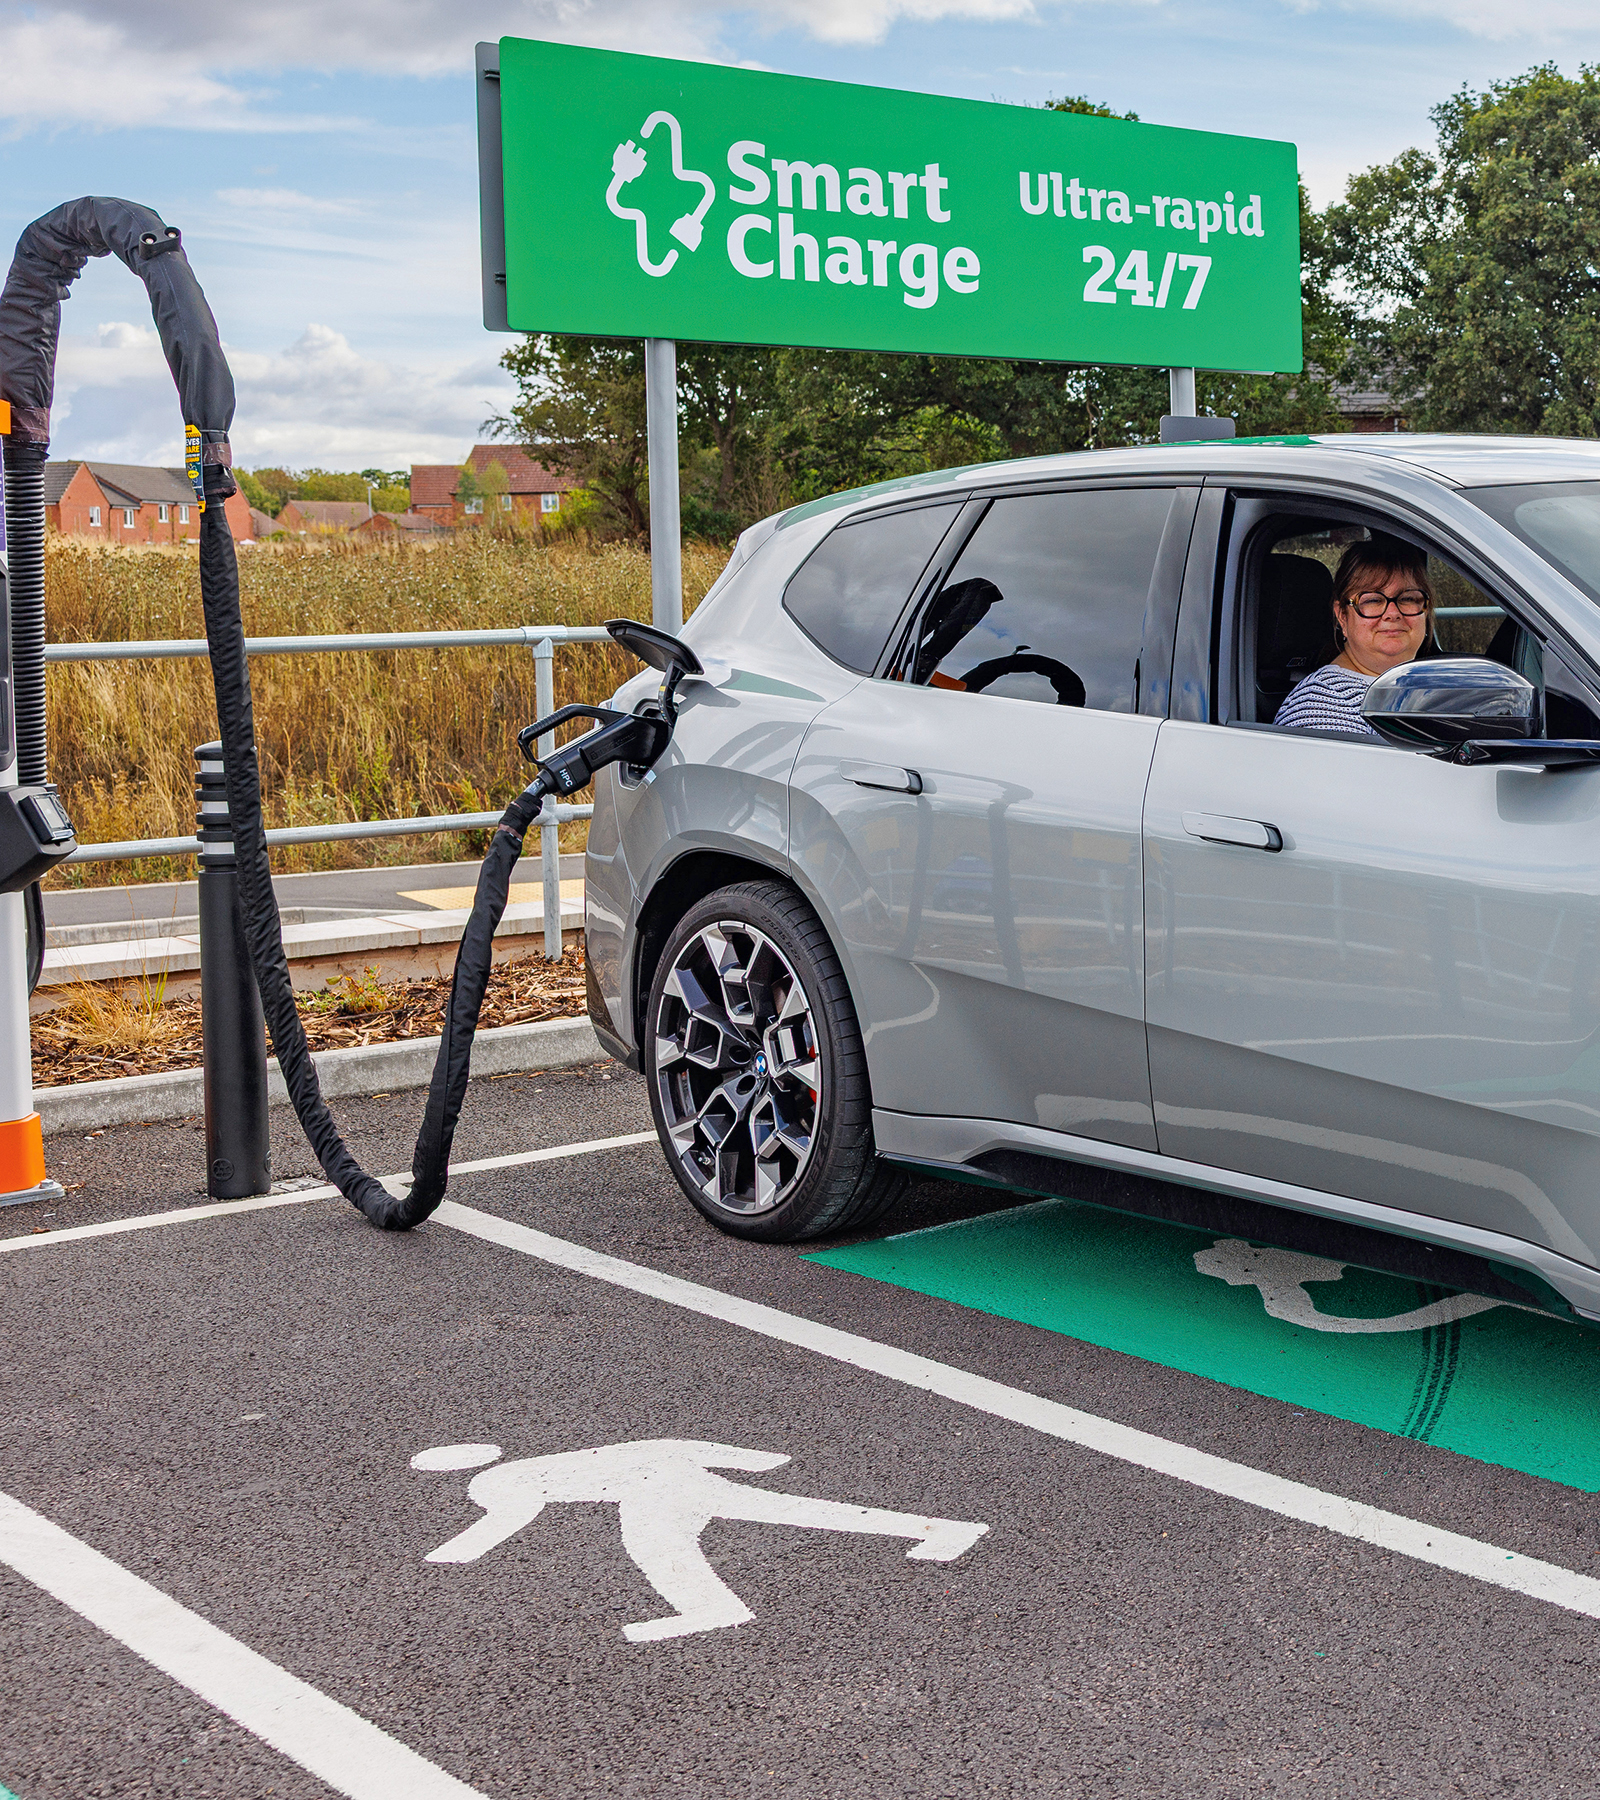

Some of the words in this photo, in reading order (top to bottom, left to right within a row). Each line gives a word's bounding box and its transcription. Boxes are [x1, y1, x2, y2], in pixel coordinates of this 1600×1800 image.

[728, 141, 951, 223] Smart
[1019, 171, 1265, 244] Ultra-rapid
[726, 213, 981, 309] Charge
[1083, 246, 1212, 310] 24/7
[186, 438, 200, 446] EVES
[559, 768, 573, 787] HPC
